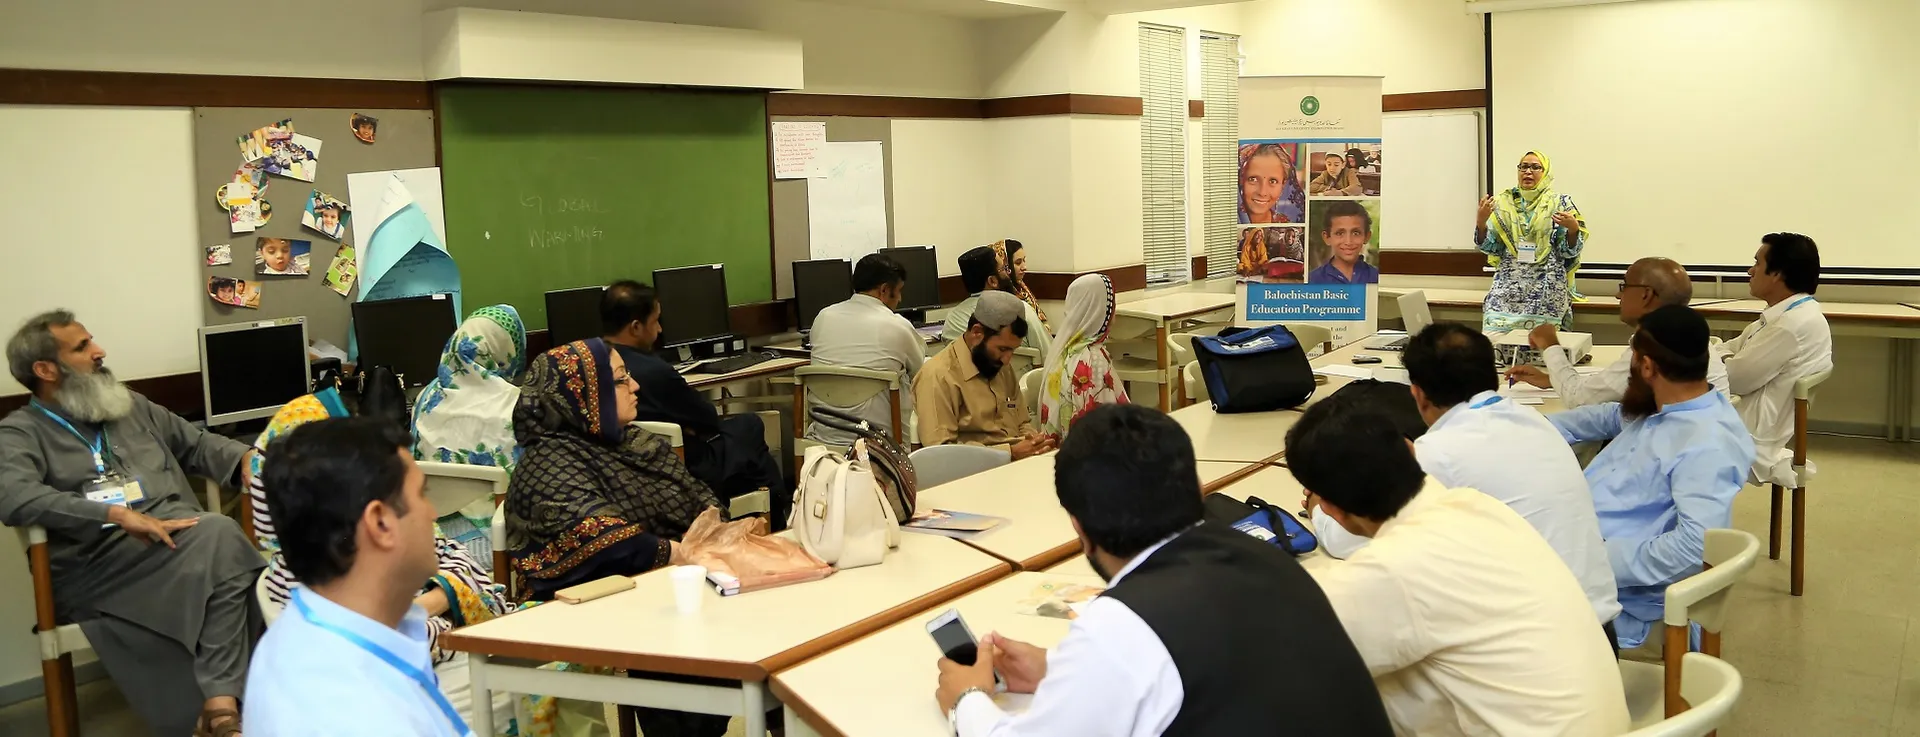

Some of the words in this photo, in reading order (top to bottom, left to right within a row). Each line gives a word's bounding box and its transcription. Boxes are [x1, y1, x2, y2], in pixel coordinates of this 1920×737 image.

[1264, 289, 1321, 300] Balochistan
[1323, 289, 1349, 300] Basic
[1251, 304, 1301, 314] Education
[1302, 304, 1361, 316] Programme
